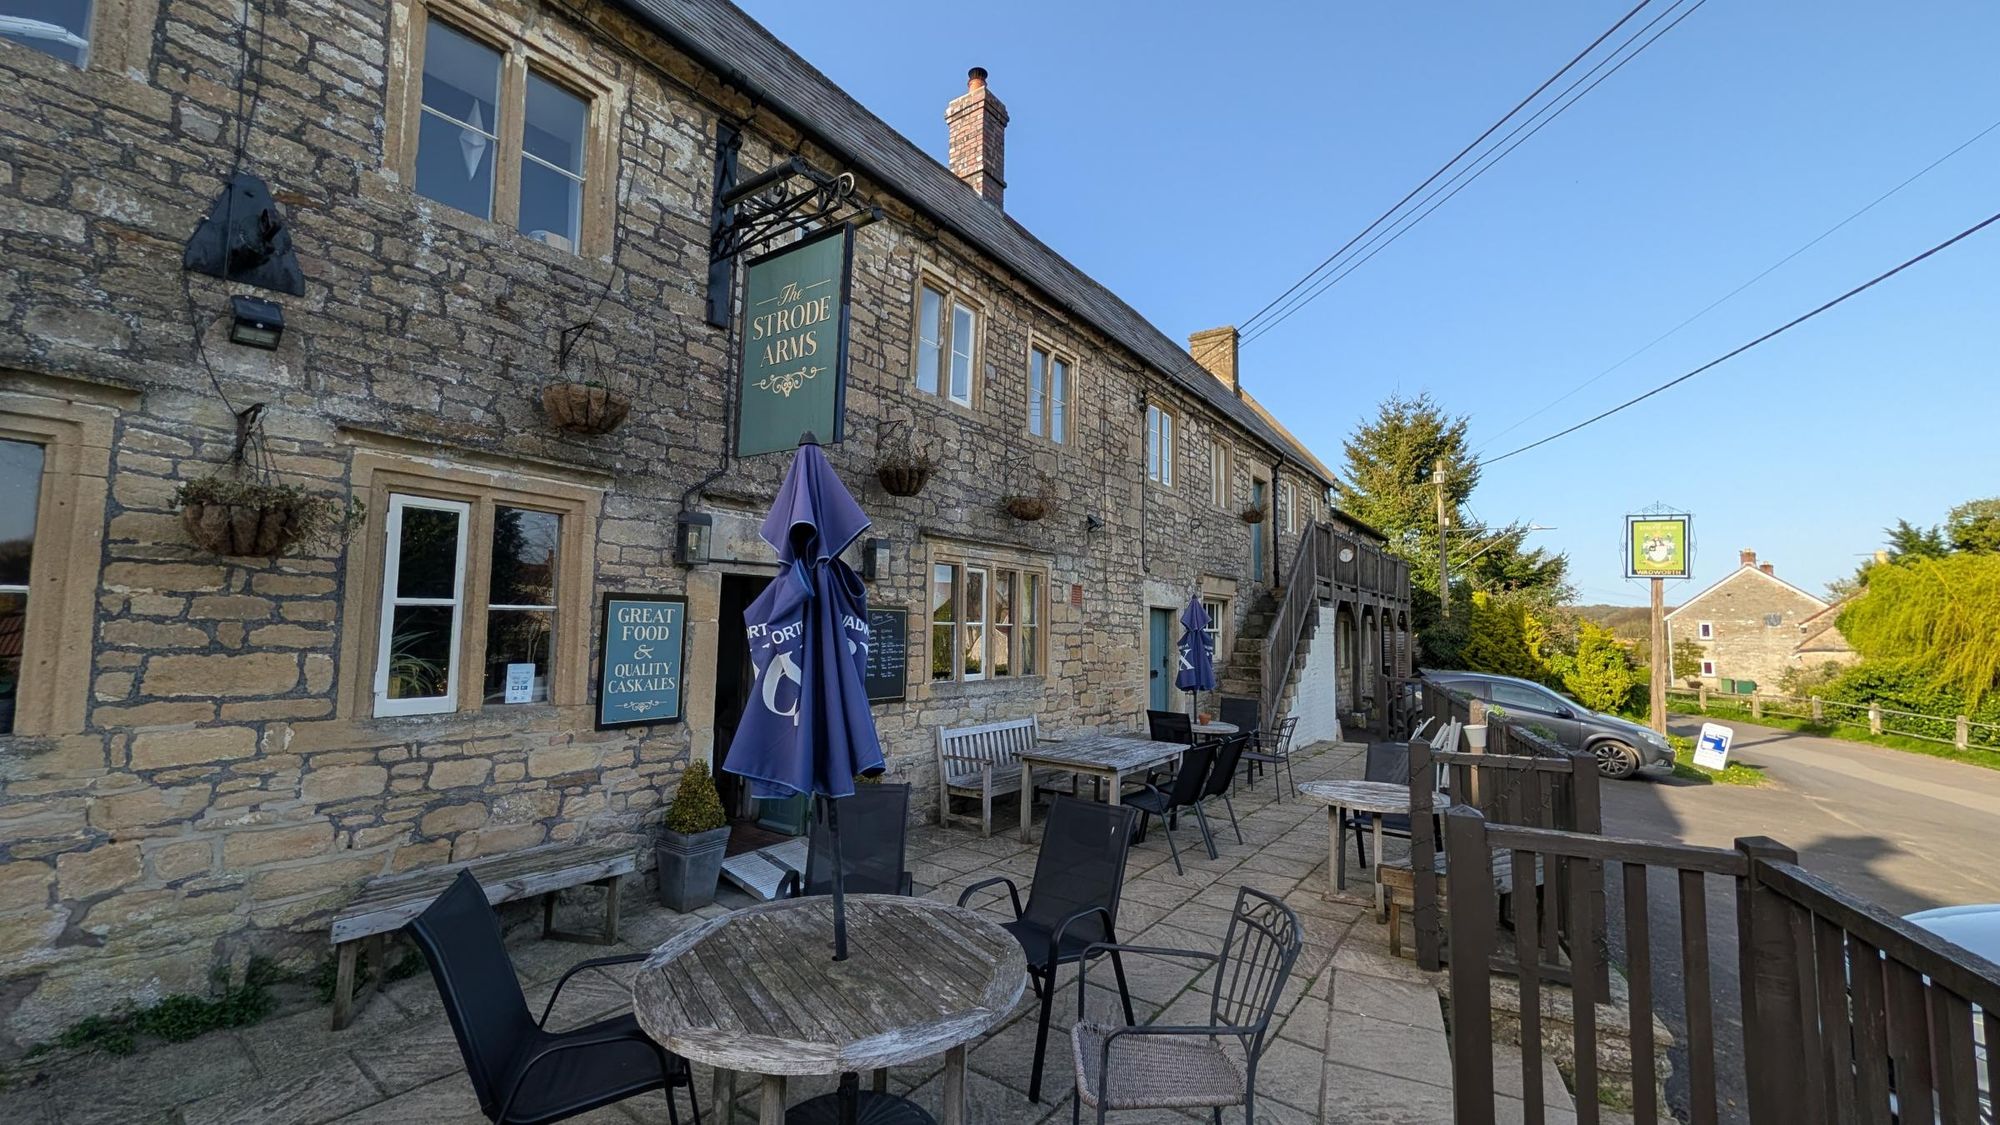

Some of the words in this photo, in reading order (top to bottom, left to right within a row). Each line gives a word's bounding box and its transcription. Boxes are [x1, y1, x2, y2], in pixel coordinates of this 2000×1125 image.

[777, 282, 804, 306] The
[753, 296, 831, 340] STRODE
[760, 331, 818, 368] ARMS
[617, 608, 675, 623] GREAT
[622, 626, 670, 641] FOOD
[633, 644, 654, 660] &
[614, 662, 672, 677] QUALITY
